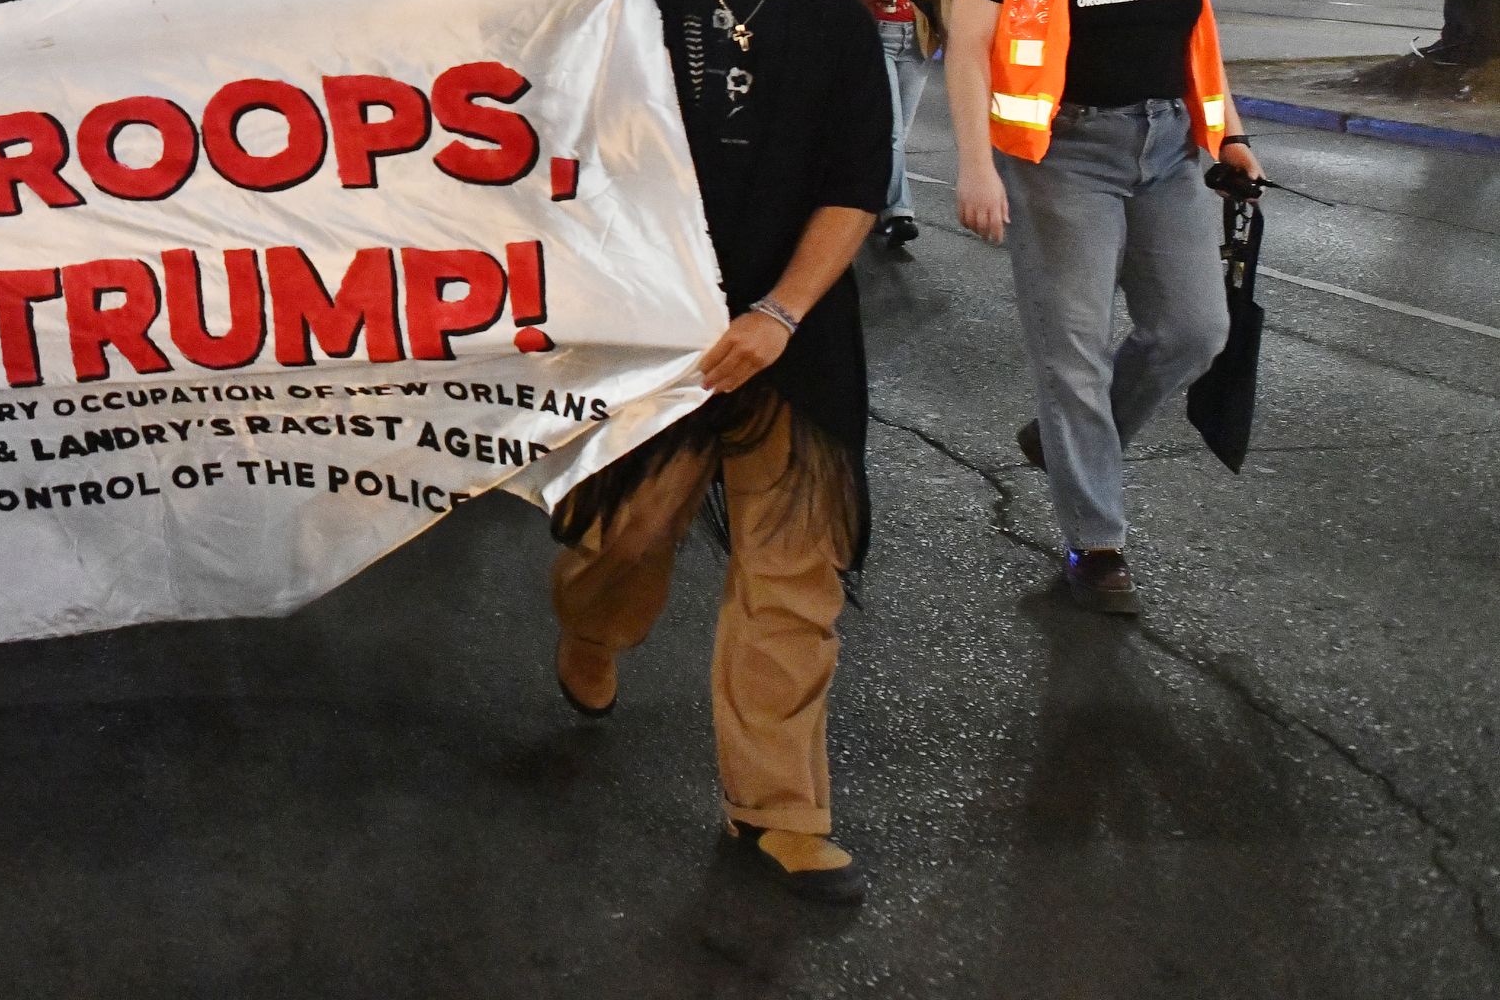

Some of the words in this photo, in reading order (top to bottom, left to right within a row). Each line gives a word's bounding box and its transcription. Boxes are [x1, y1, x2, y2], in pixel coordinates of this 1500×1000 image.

[52, 384, 276, 417] OCCUPATION
[286, 384, 335, 399] OF
[442, 380, 611, 422] ORLEANS
[30, 418, 236, 462] LANDRY'S
[244, 413, 404, 441] RACIST
[171, 462, 225, 490] OF
[236, 460, 316, 488] THE
